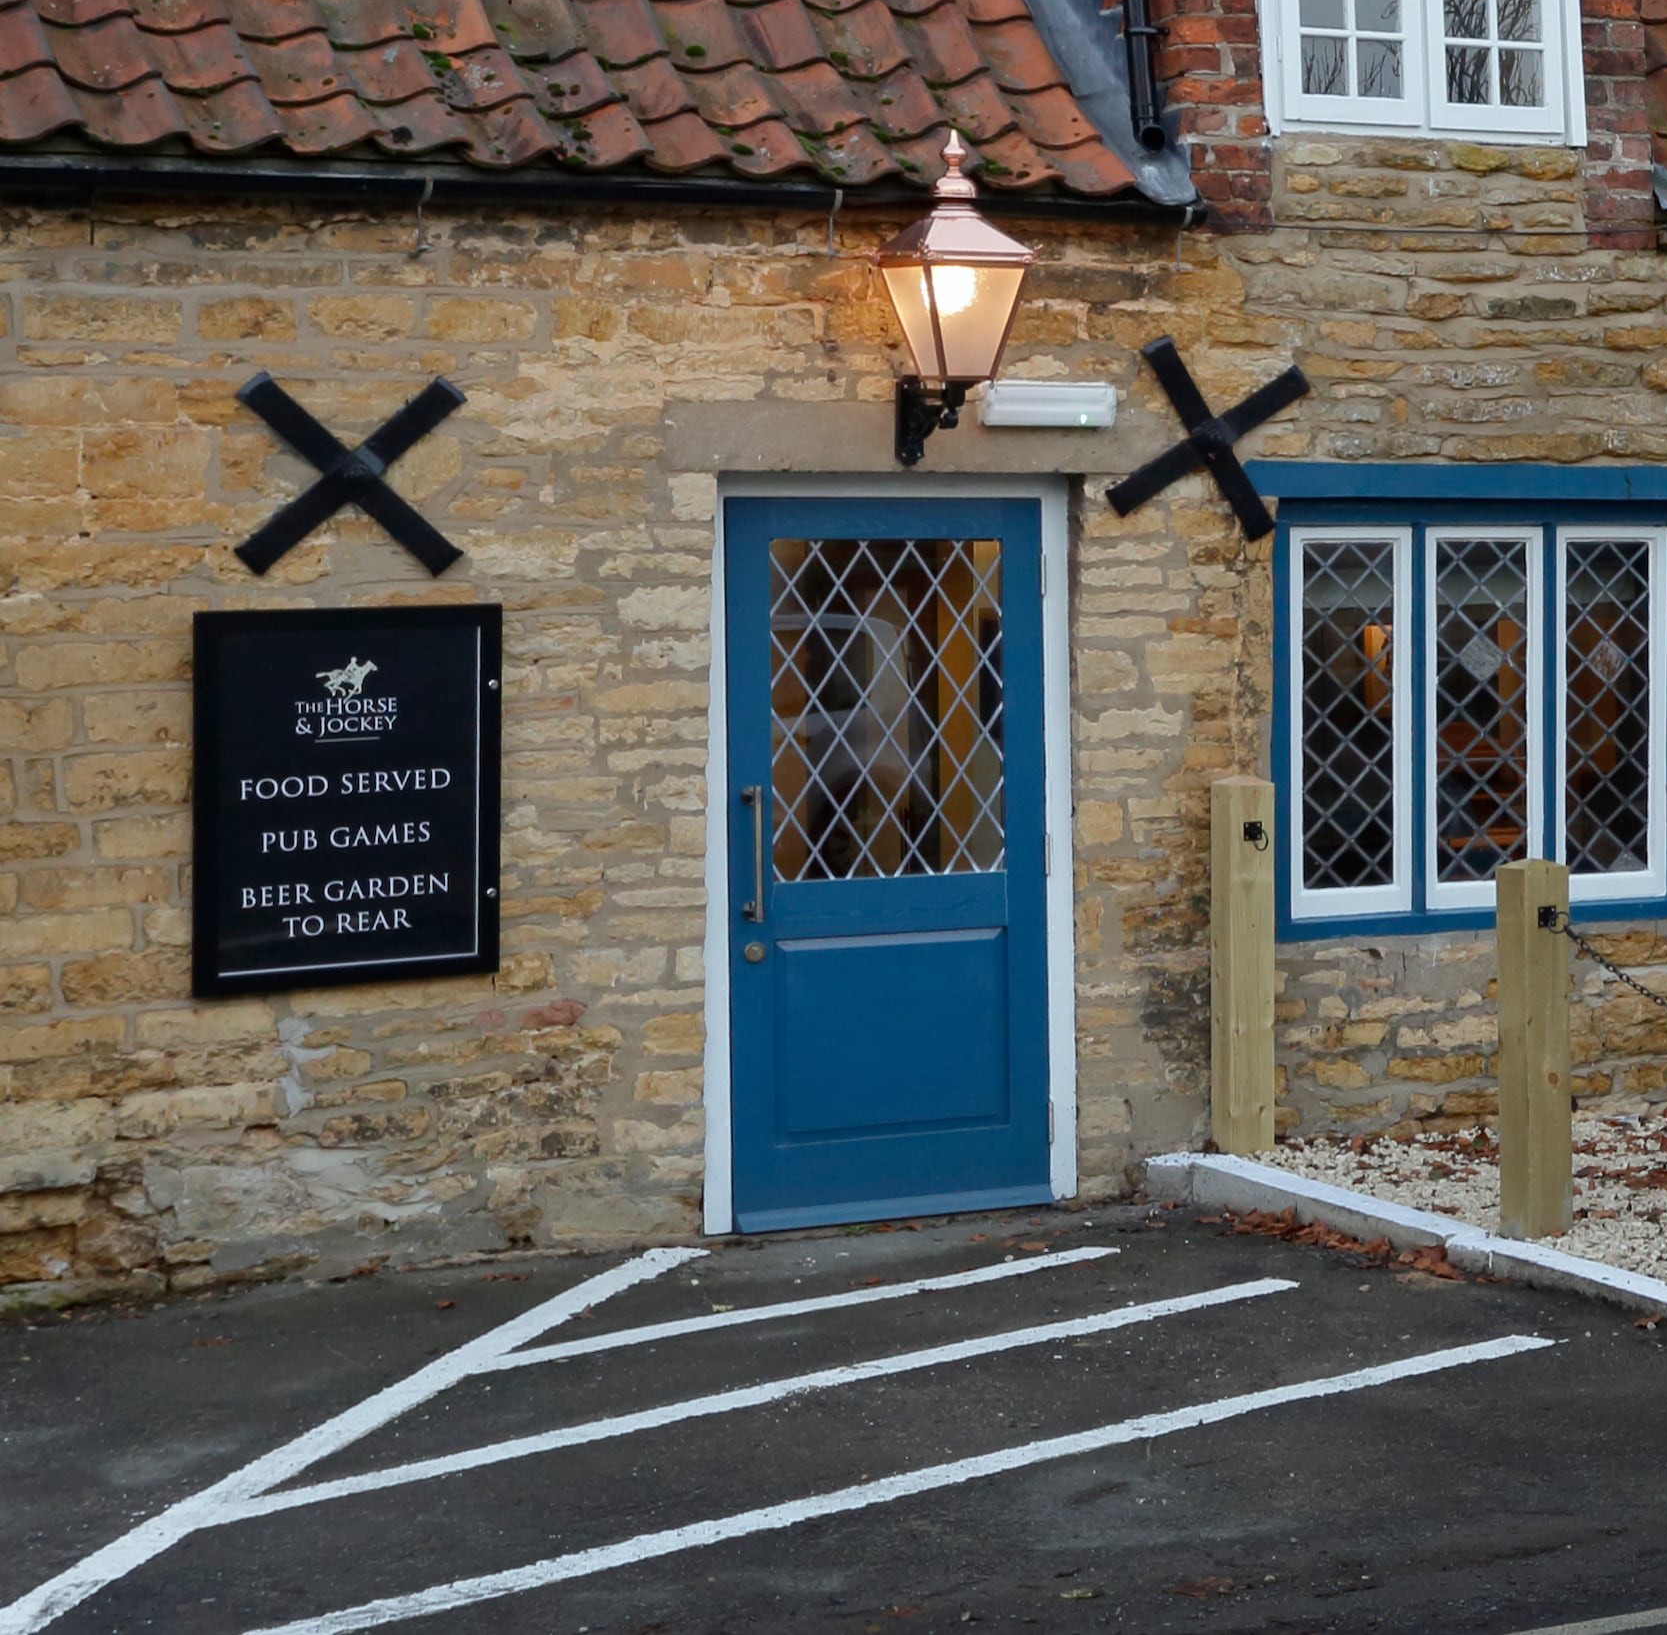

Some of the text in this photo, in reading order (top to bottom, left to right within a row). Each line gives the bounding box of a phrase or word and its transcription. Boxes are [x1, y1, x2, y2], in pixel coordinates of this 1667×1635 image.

[294, 697, 397, 715] THE HORSE
[295, 715, 397, 738] & JOCKEY
[240, 768, 451, 801] FOOD SERVED
[261, 821, 431, 853] PUB GAMES
[241, 873, 450, 909] BEER GARDEN
[282, 909, 412, 938] TO REAR
